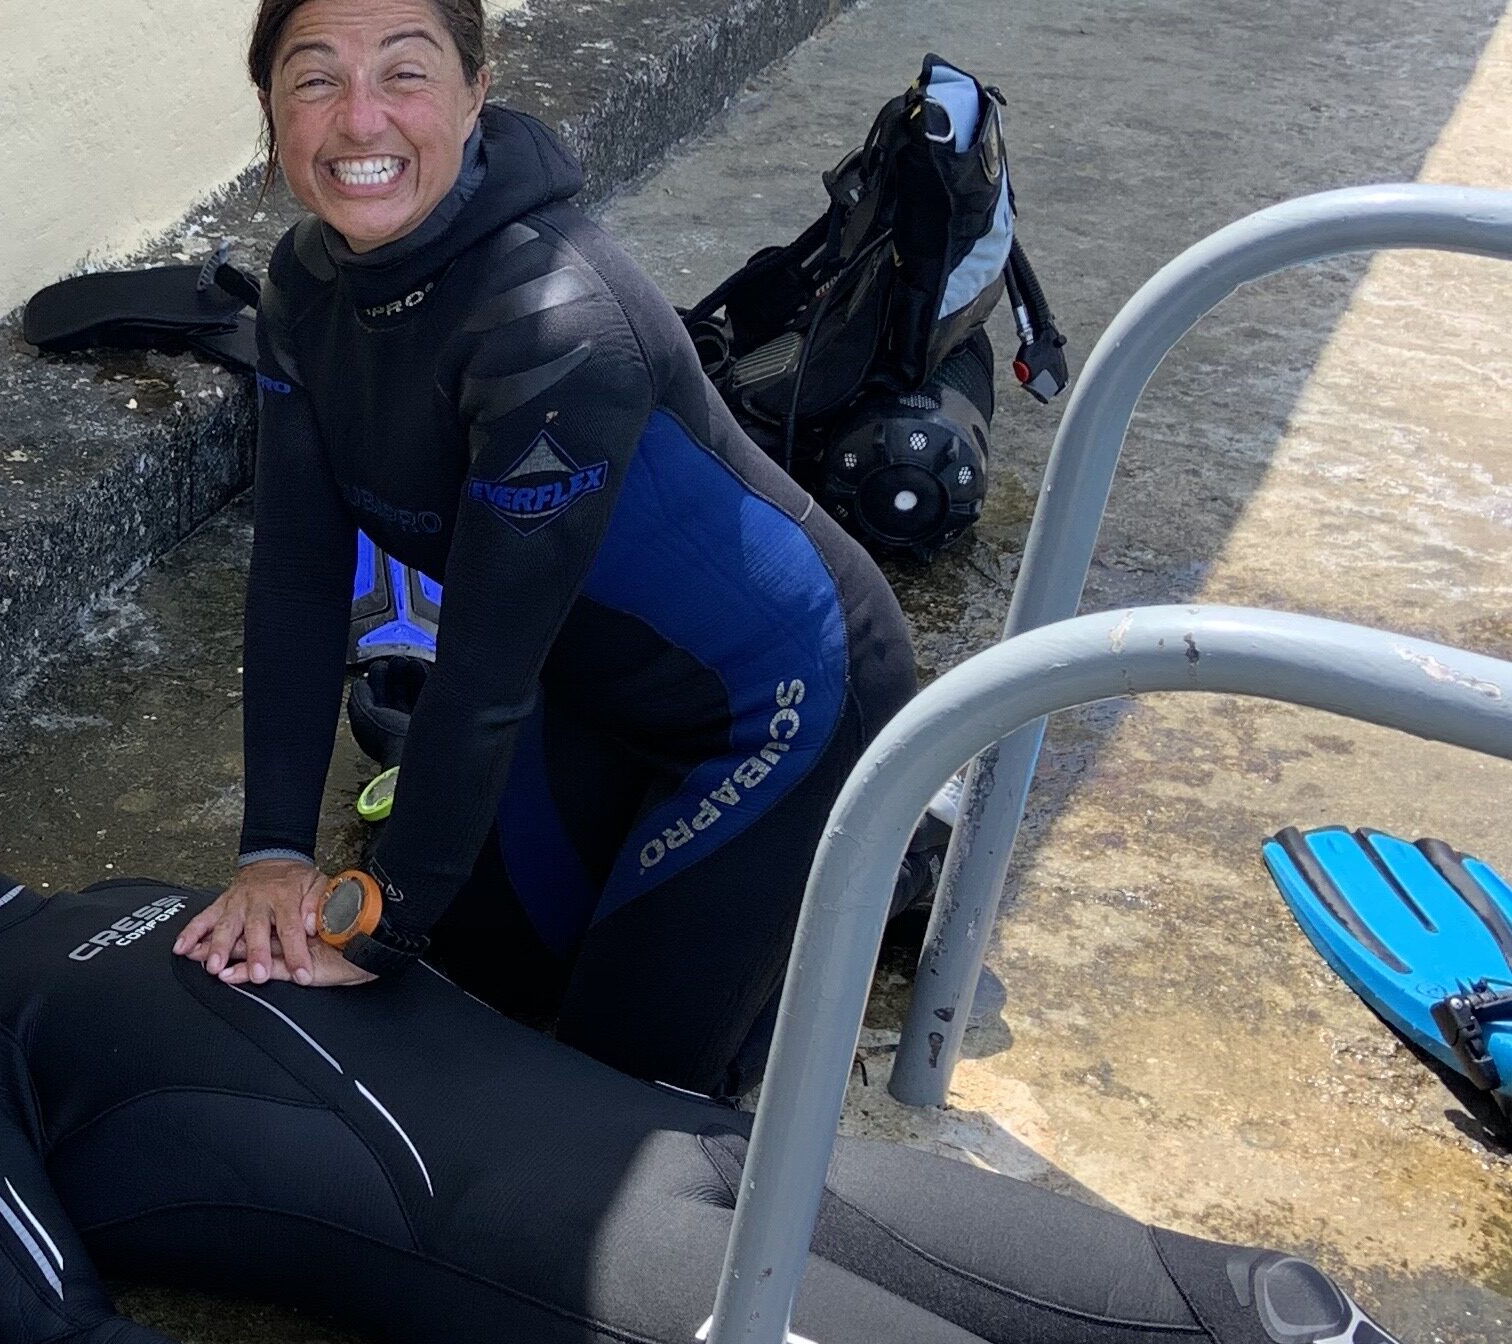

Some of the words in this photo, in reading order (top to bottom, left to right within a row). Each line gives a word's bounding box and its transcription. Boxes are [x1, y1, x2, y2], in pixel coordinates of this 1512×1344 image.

[469, 467, 605, 513] EVERFLEX
[639, 678, 806, 869] SCUBAPRO
[68, 894, 189, 961] CRESSI
[115, 902, 186, 946] COMFORT
